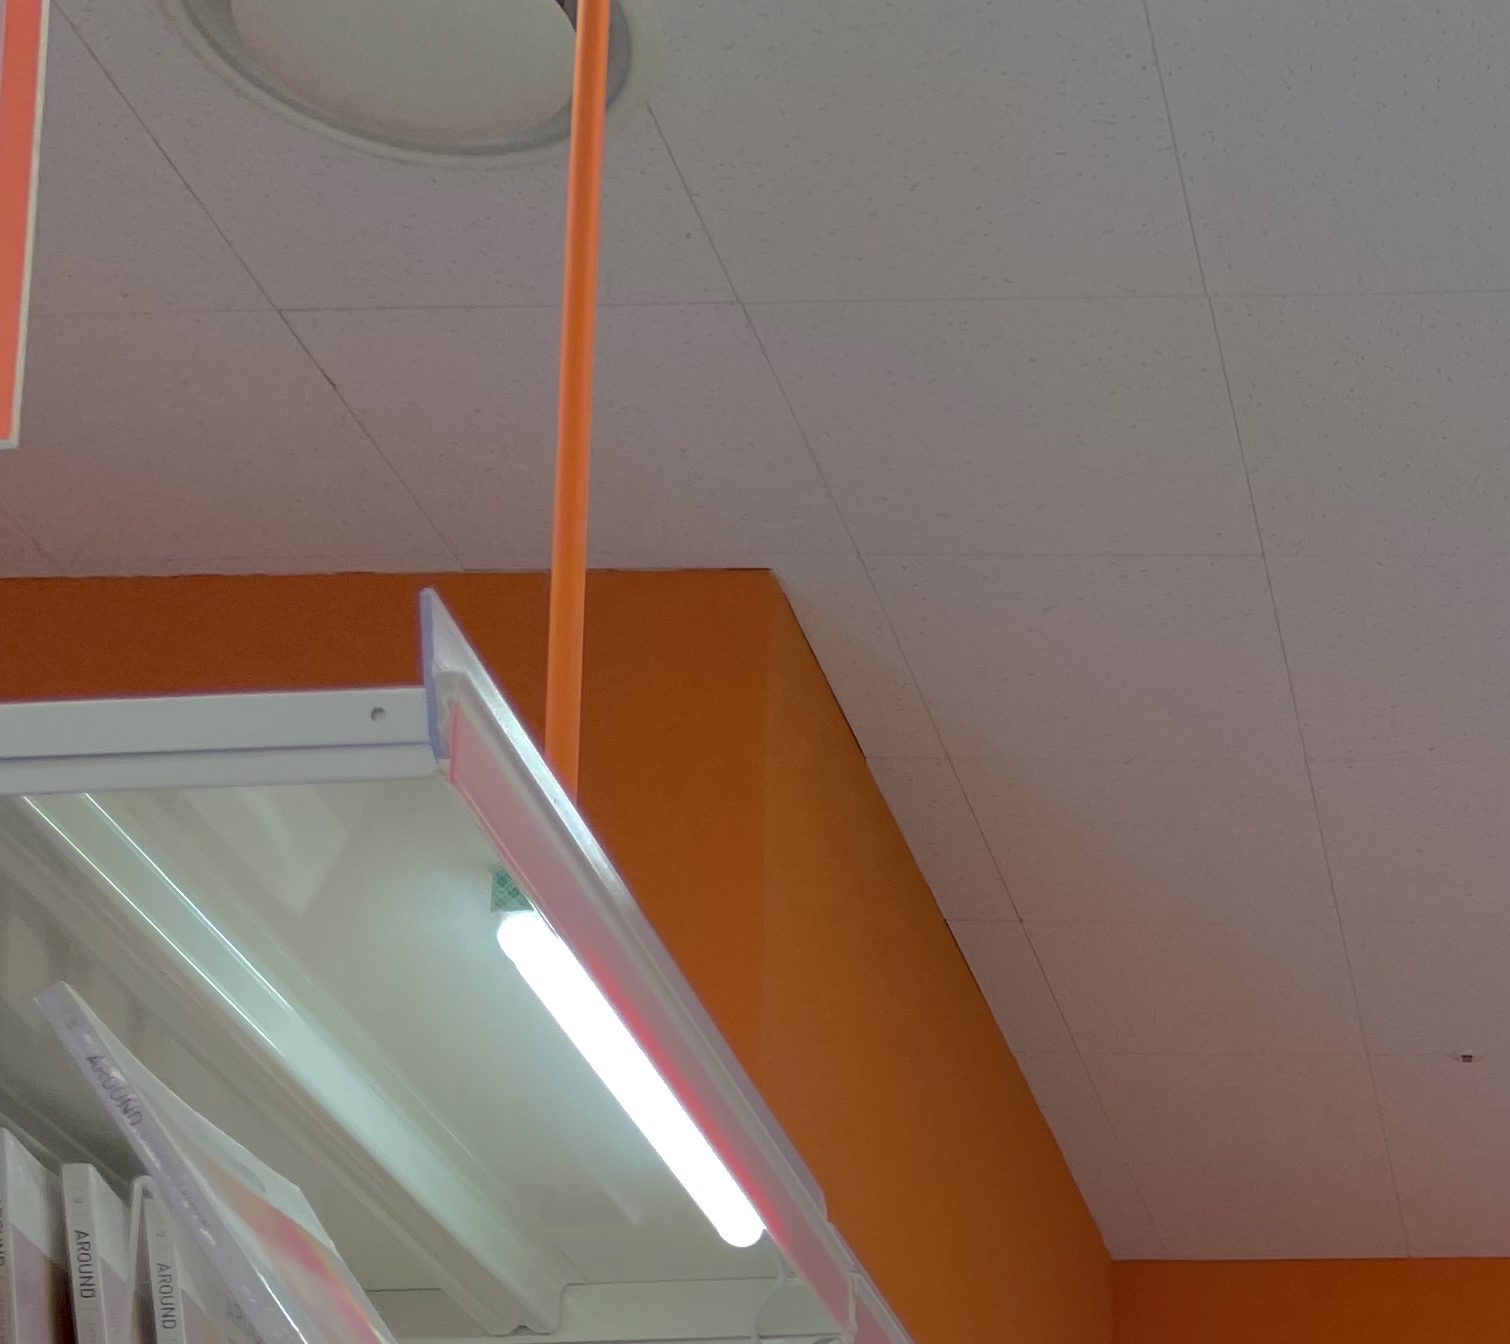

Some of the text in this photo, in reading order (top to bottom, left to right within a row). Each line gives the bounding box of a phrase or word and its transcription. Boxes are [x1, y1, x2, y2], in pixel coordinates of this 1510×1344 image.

[86, 1055, 143, 1126] AROUND
[74, 1229, 96, 1300] AROUND
[156, 1262, 176, 1330] AROUND
